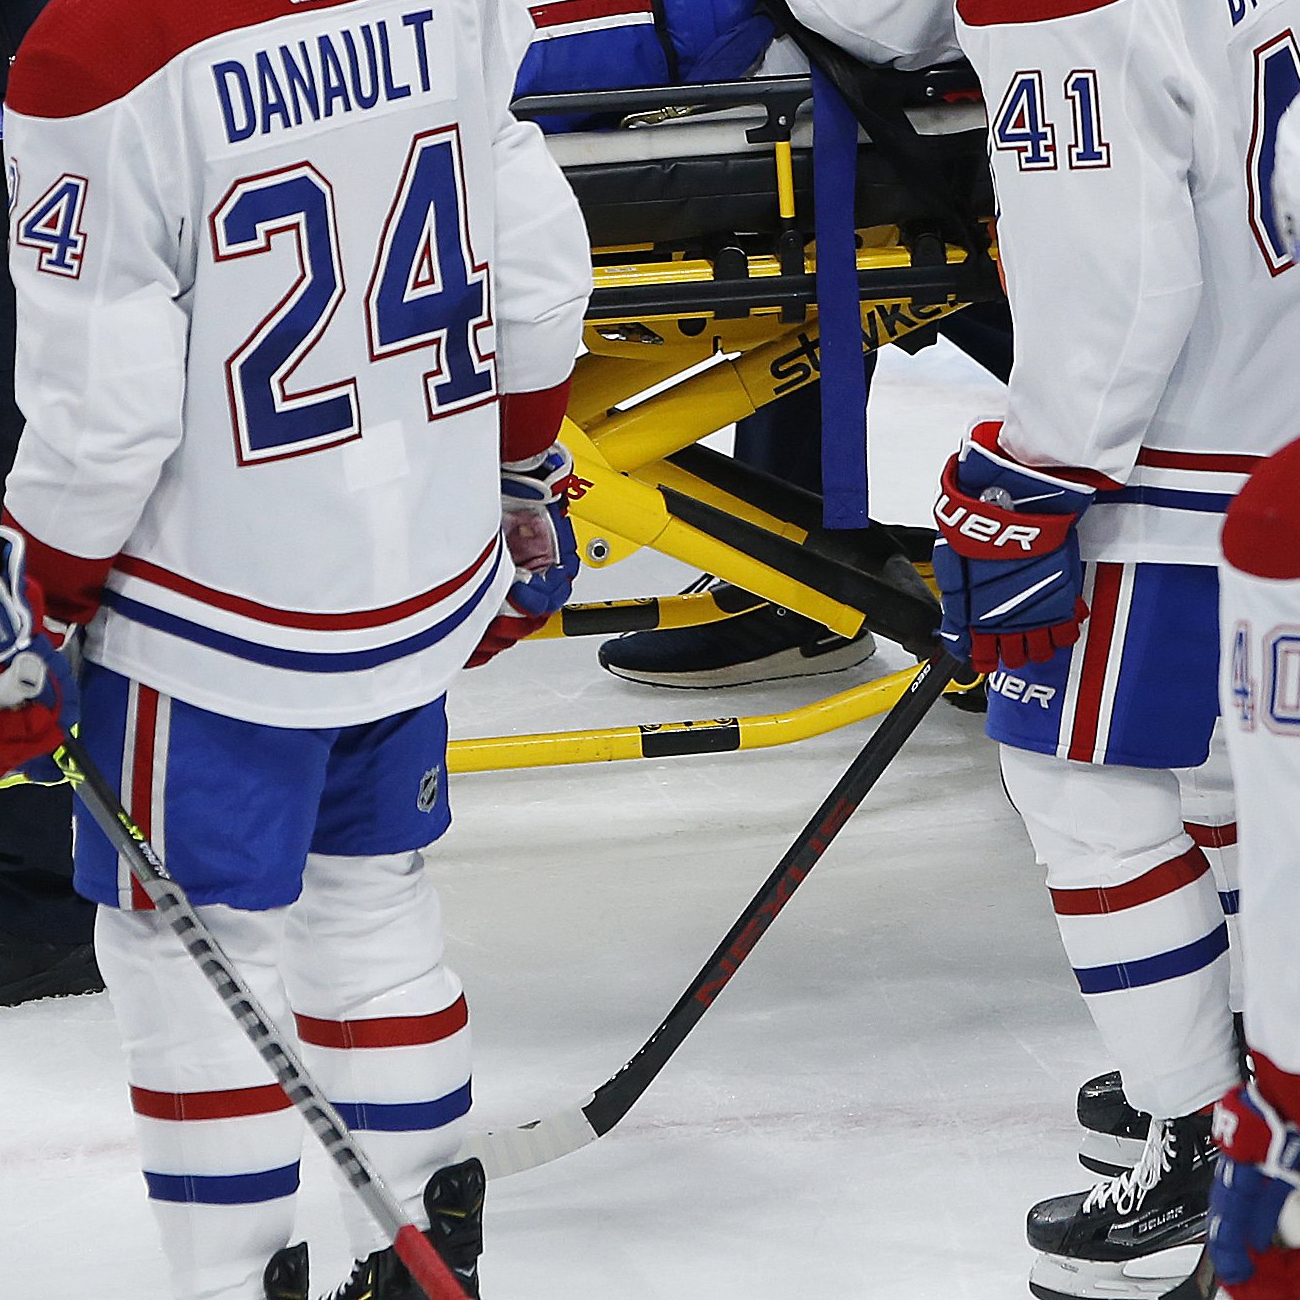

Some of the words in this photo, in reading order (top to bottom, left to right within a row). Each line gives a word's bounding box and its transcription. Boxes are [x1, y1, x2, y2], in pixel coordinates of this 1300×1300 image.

[212, 9, 435, 144] DANAULT
[992, 68, 1112, 174] 41
[209, 122, 499, 467] 24
[934, 494, 1041, 551] UER
[988, 670, 1057, 710] UER
